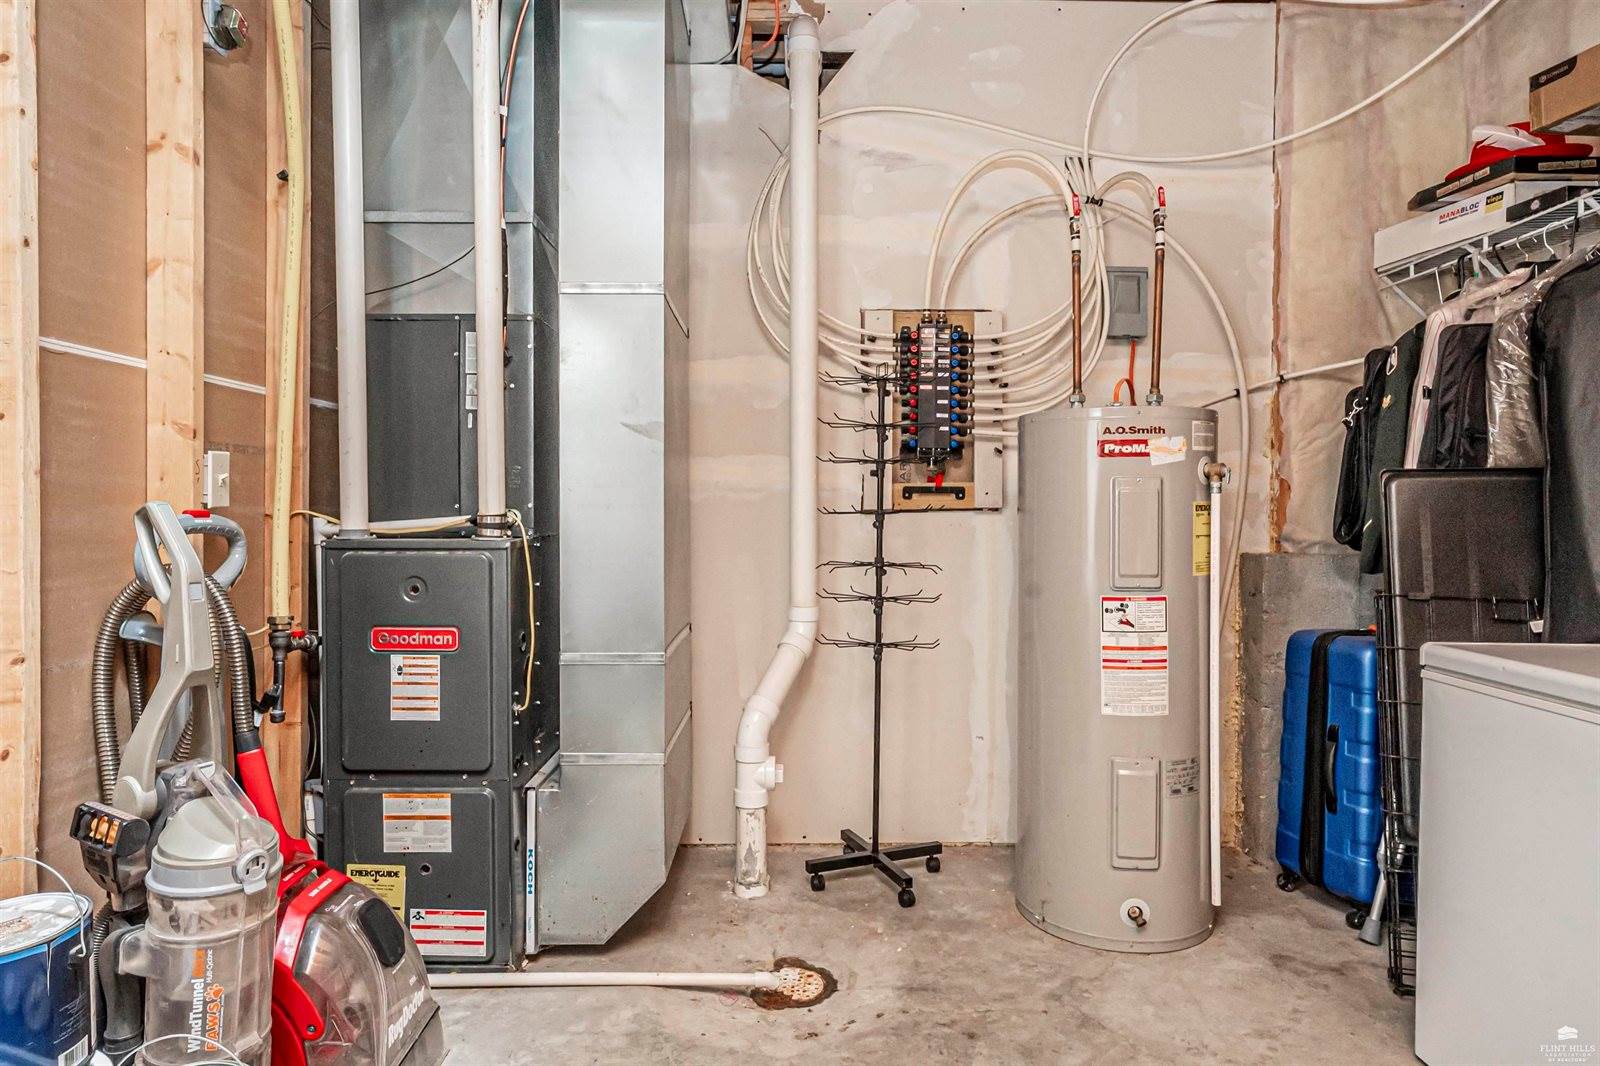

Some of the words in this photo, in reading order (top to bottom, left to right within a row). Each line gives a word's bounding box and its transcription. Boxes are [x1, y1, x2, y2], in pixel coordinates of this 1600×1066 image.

[1439, 202, 1480, 221] MANABLOC
[1103, 426, 1166, 435] A.O.Smith
[377, 632, 452, 645] Goodman
[187, 979, 204, 1053] WindTunnel
